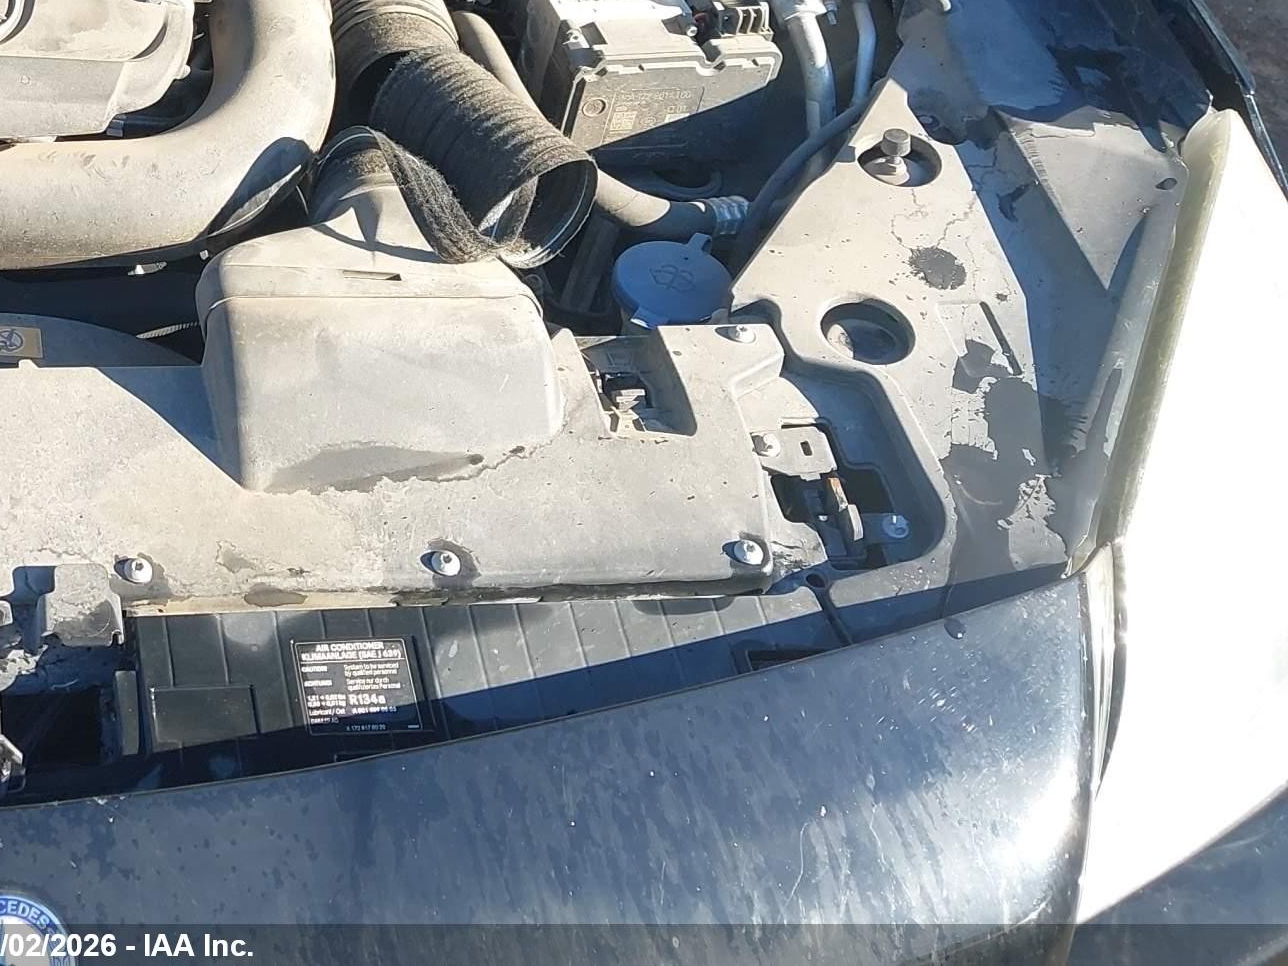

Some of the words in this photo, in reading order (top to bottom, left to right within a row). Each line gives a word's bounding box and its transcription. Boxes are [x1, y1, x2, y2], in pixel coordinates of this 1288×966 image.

[315, 644, 329, 652] AIR
[330, 641, 384, 651] CONDITIONER
[301, 651, 357, 661] KLIMAANLAGE
[358, 650, 377, 660] (SAE
[383, 649, 402, 659] 639)
[348, 693, 386, 706] R134a
